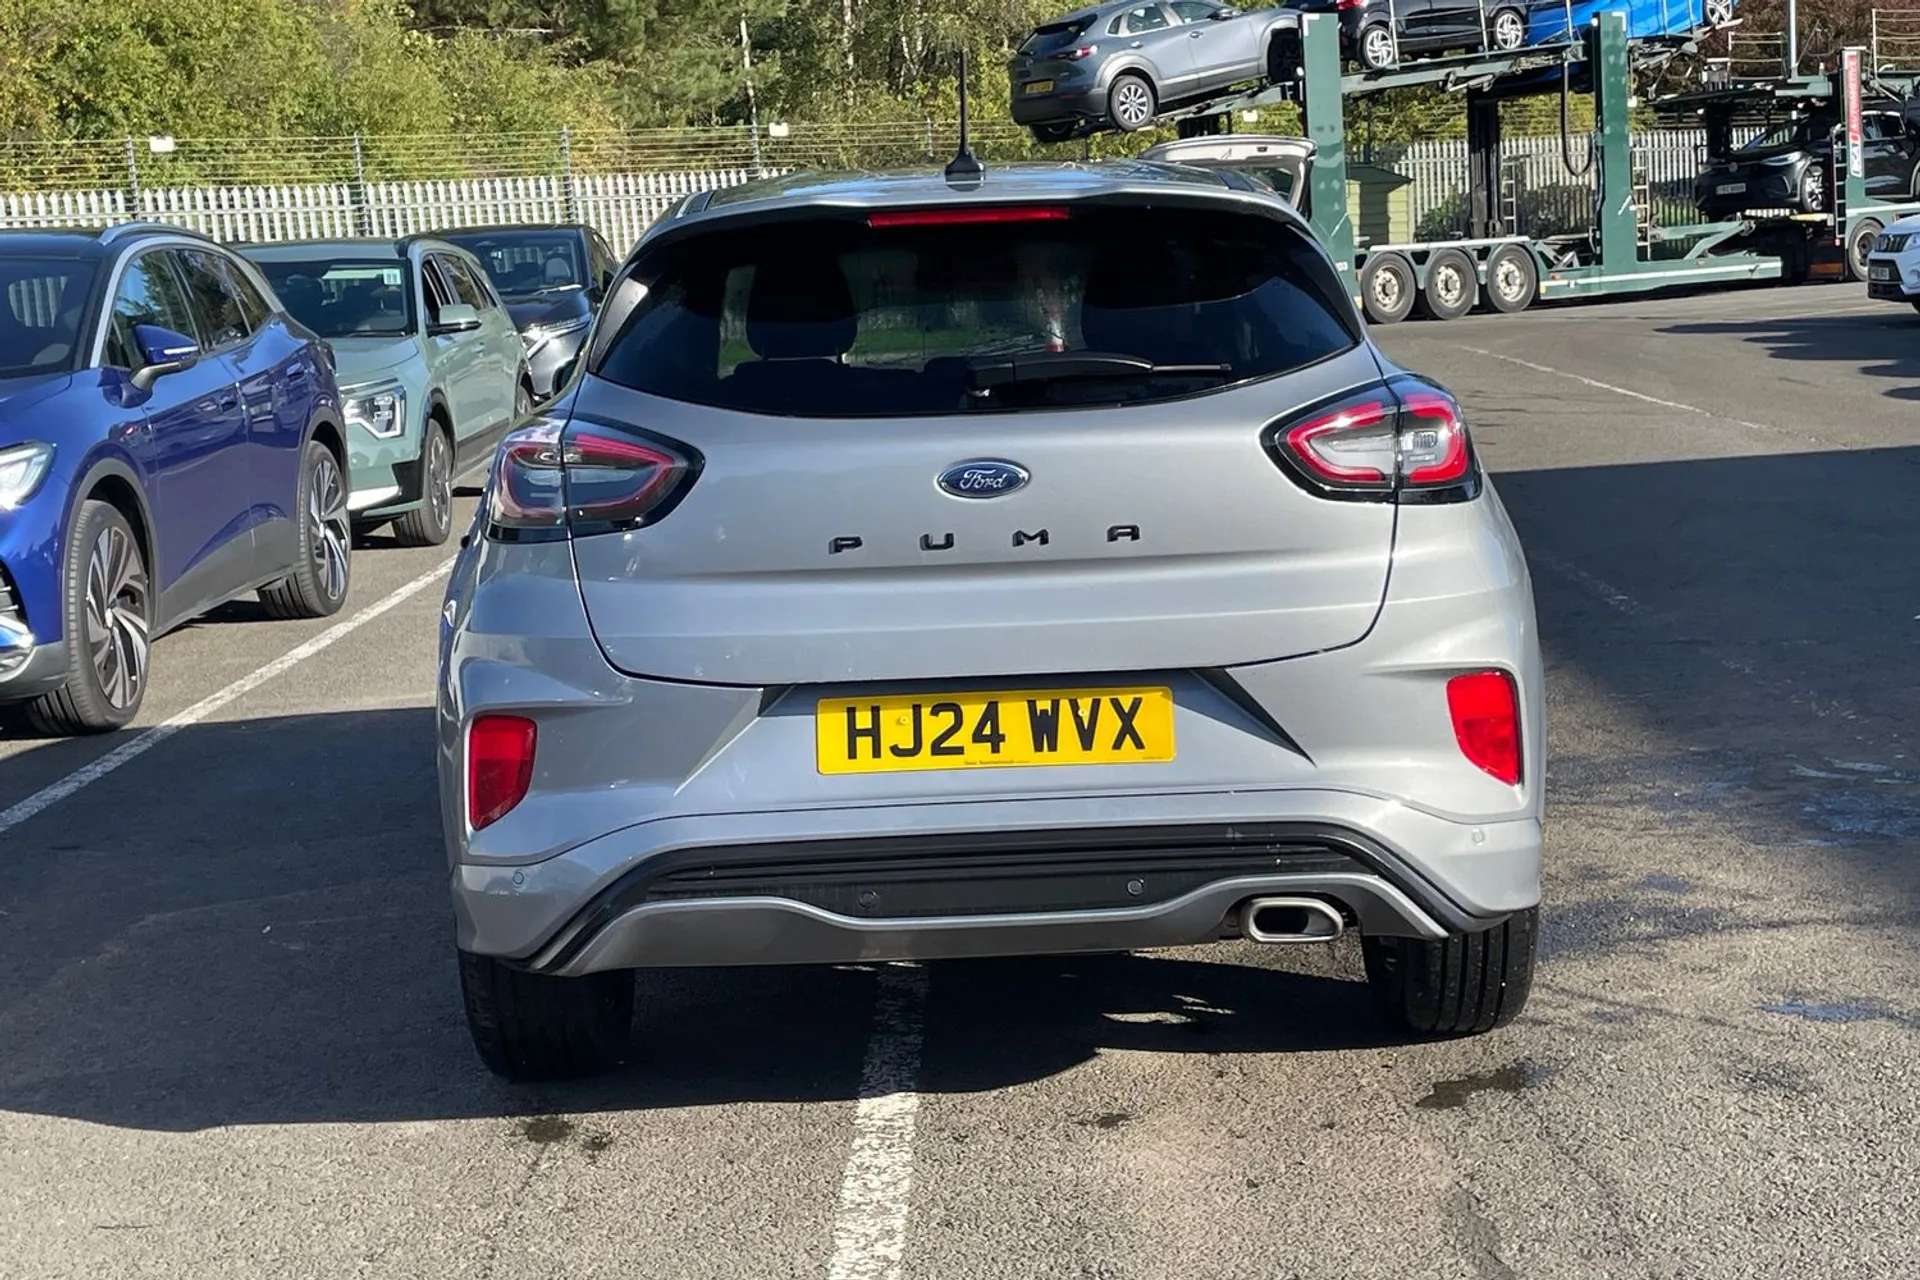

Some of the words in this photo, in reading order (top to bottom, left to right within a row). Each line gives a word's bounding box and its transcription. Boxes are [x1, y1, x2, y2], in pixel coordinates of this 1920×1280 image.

[959, 468, 1008, 490] Ford
[828, 524, 1141, 555] PUMA
[846, 700, 1006, 760] HJ24
[1027, 696, 1146, 753] WVX
